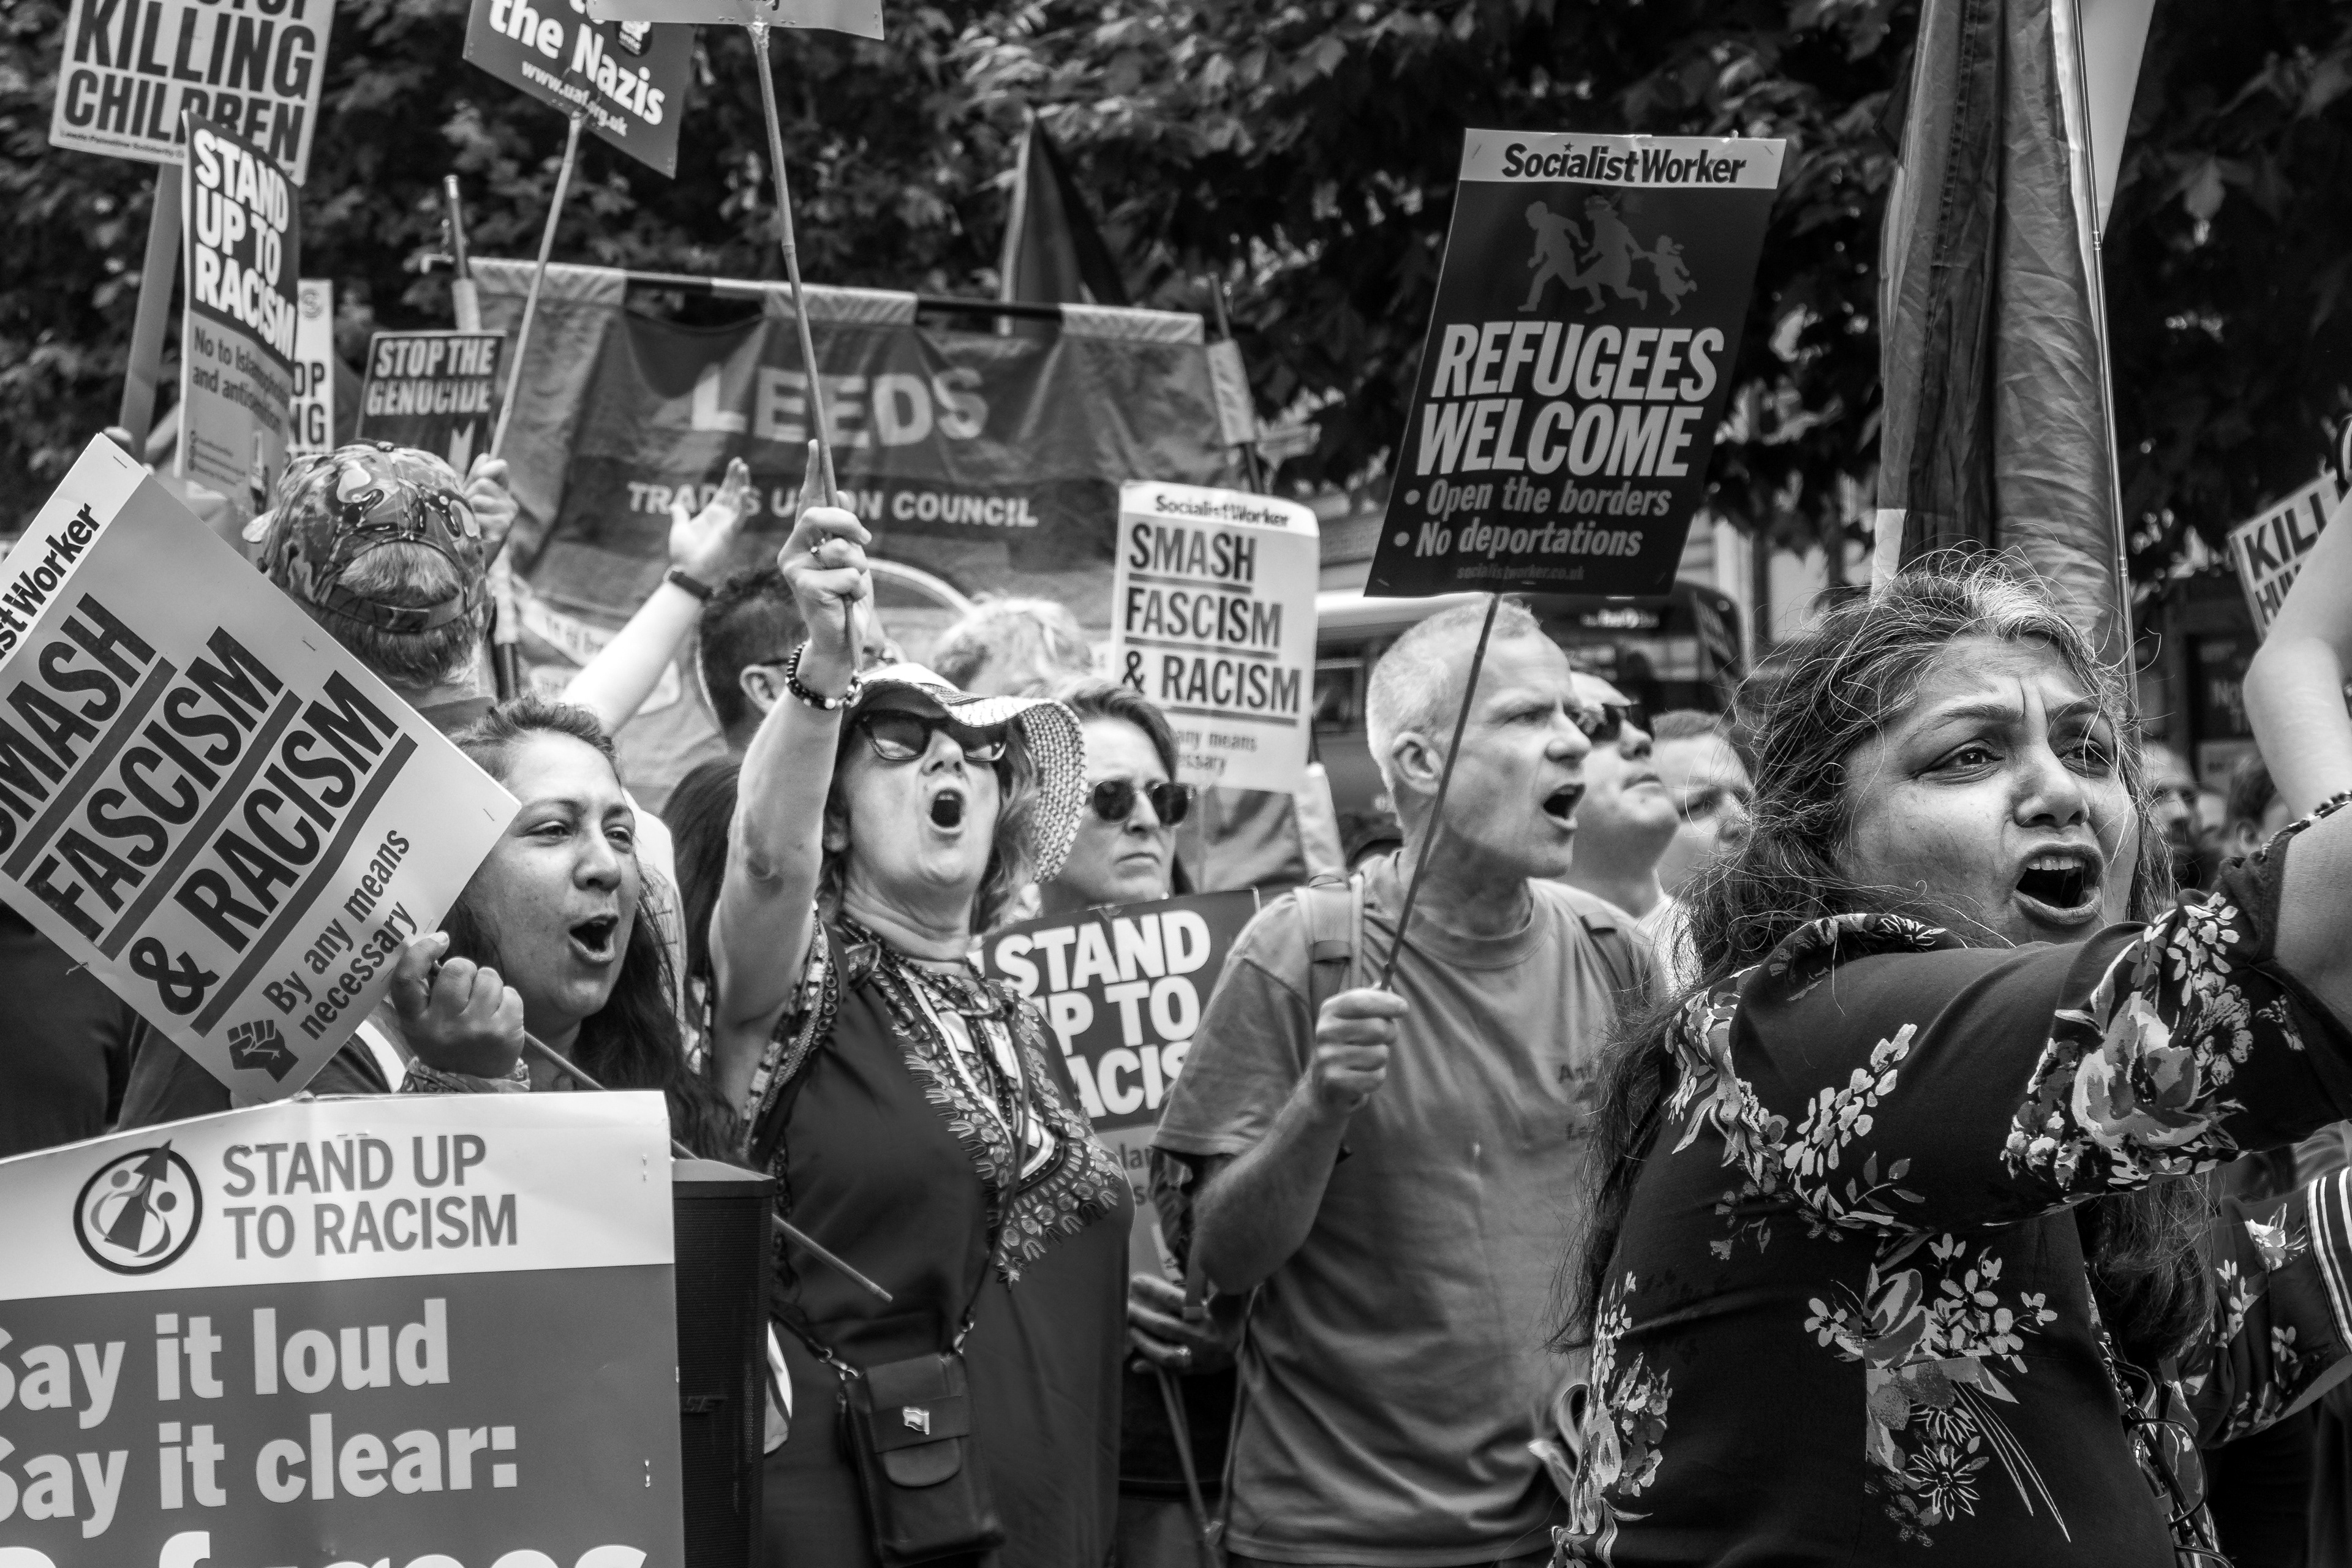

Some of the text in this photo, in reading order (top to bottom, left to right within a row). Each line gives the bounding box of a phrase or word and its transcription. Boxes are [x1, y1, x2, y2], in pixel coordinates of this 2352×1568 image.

[74, 0, 315, 100] KILLING
[490, 0, 564, 59] the
[571, 23, 665, 125] Nazis
[65, 69, 304, 162] CHILDREN
[194, 128, 289, 233] STAND
[196, 184, 281, 287] UP TO
[195, 243, 295, 361] RACISM
[193, 366, 219, 394] and
[194, 325, 213, 358] No
[218, 339, 232, 366] to
[375, 338, 496, 378] STOP THE
[1431, 321, 1724, 402] REFUGEES
[366, 380, 490, 417] GENOCIDE
[692, 366, 989, 448] LEEDS
[1416, 398, 1703, 477] WELCOME
[892, 491, 1039, 528] COUNCIL
[1415, 516, 1643, 560] No deportations
[1427, 476, 1672, 522] Open the borders
[1129, 522, 1257, 582] SMASH
[1126, 586, 1283, 648] FASCISM
[1122, 650, 1301, 713] & RACISM
[0, 592, 156, 855] MASH
[1209, 731, 1257, 754] means
[23, 626, 284, 943] FASCISM
[129, 670, 399, 1016] & RACISM
[262, 830, 409, 1015] By any means
[995, 910, 1211, 996] STAND
[300, 902, 417, 1040] necessary
[1033, 976, 1200, 1056] P TO
[222, 1134, 486, 1198] STAND UP
[223, 1193, 518, 1261] TO RACISM
[156, 1313, 224, 1401] it
[253, 1298, 450, 1395] loud
[159, 1422, 227, 1510] it
[256, 1413, 517, 1504] clear:
